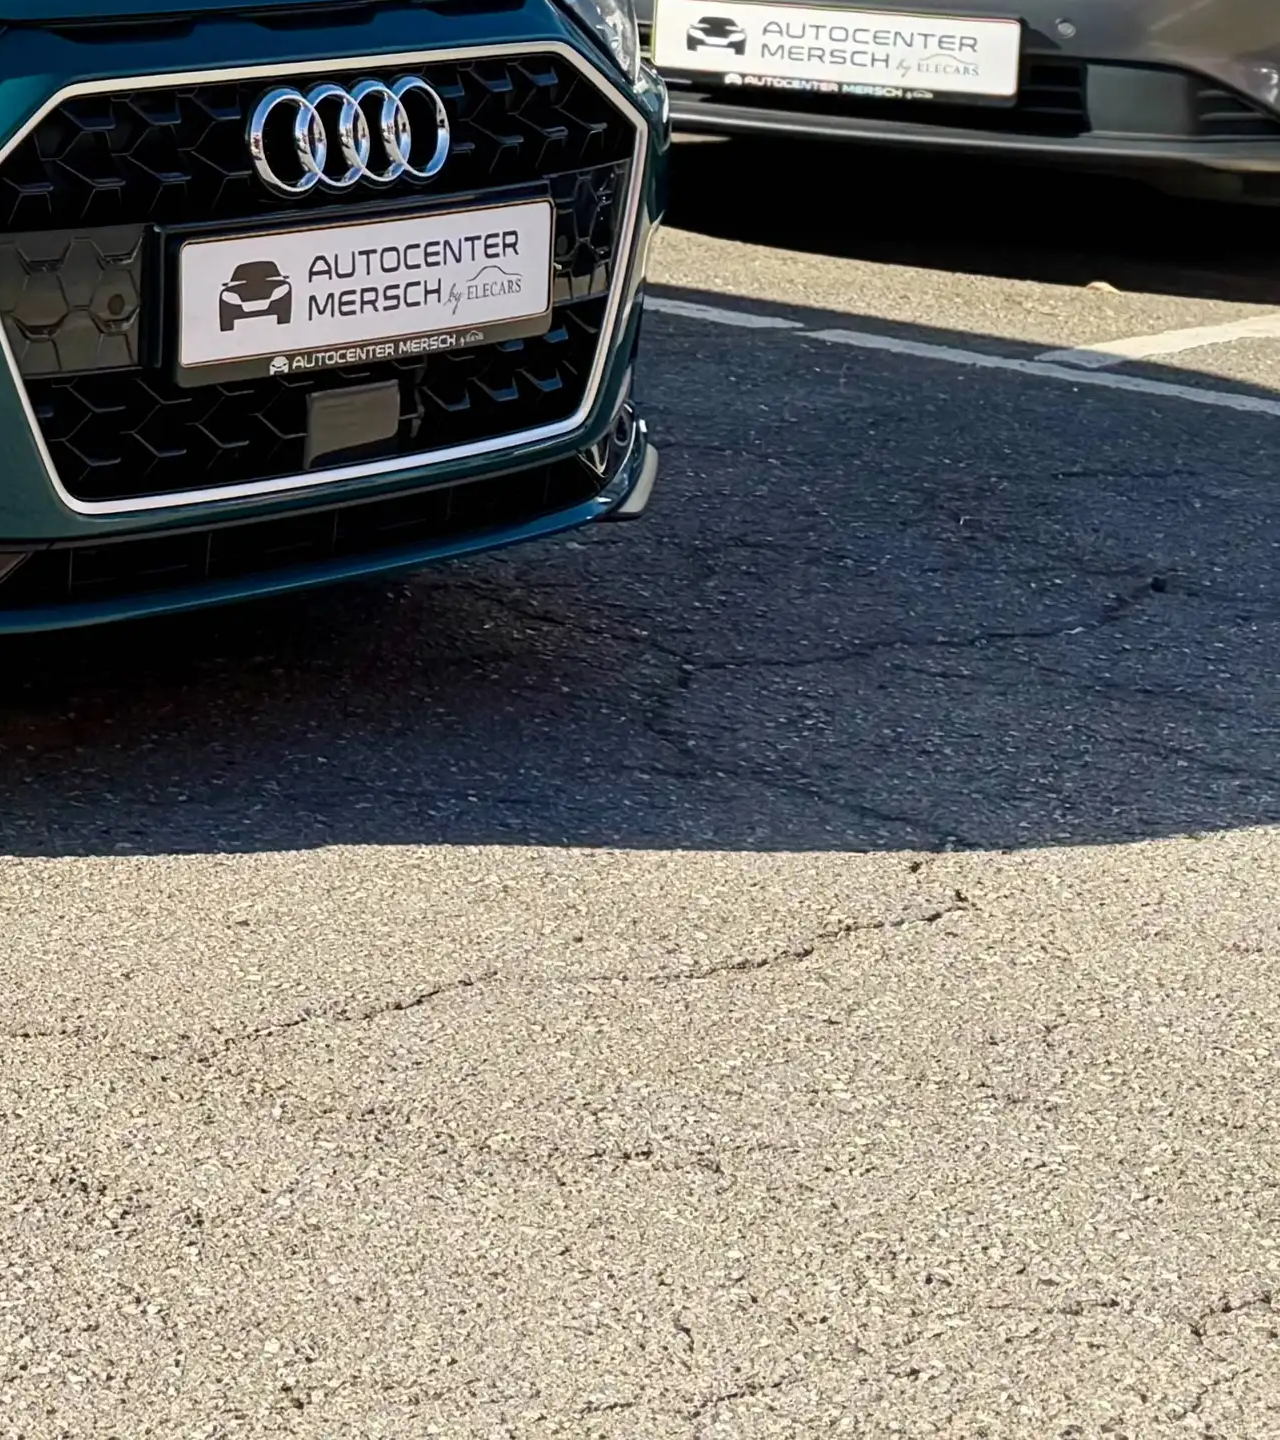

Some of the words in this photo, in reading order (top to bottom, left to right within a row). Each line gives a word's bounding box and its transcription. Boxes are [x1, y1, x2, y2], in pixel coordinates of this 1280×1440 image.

[761, 20, 978, 53] AUTOCENTER
[760, 43, 890, 69] MERSCH
[743, 74, 839, 93] AUTOCENTER
[842, 83, 903, 99] MERSCH
[307, 229, 520, 284] AUTOCENTER
[307, 277, 442, 322] MERSCH
[442, 283, 465, 315] by
[466, 278, 522, 300] ELECARS
[292, 342, 396, 371] AUTOCENTER
[398, 333, 457, 355] MERSCH
